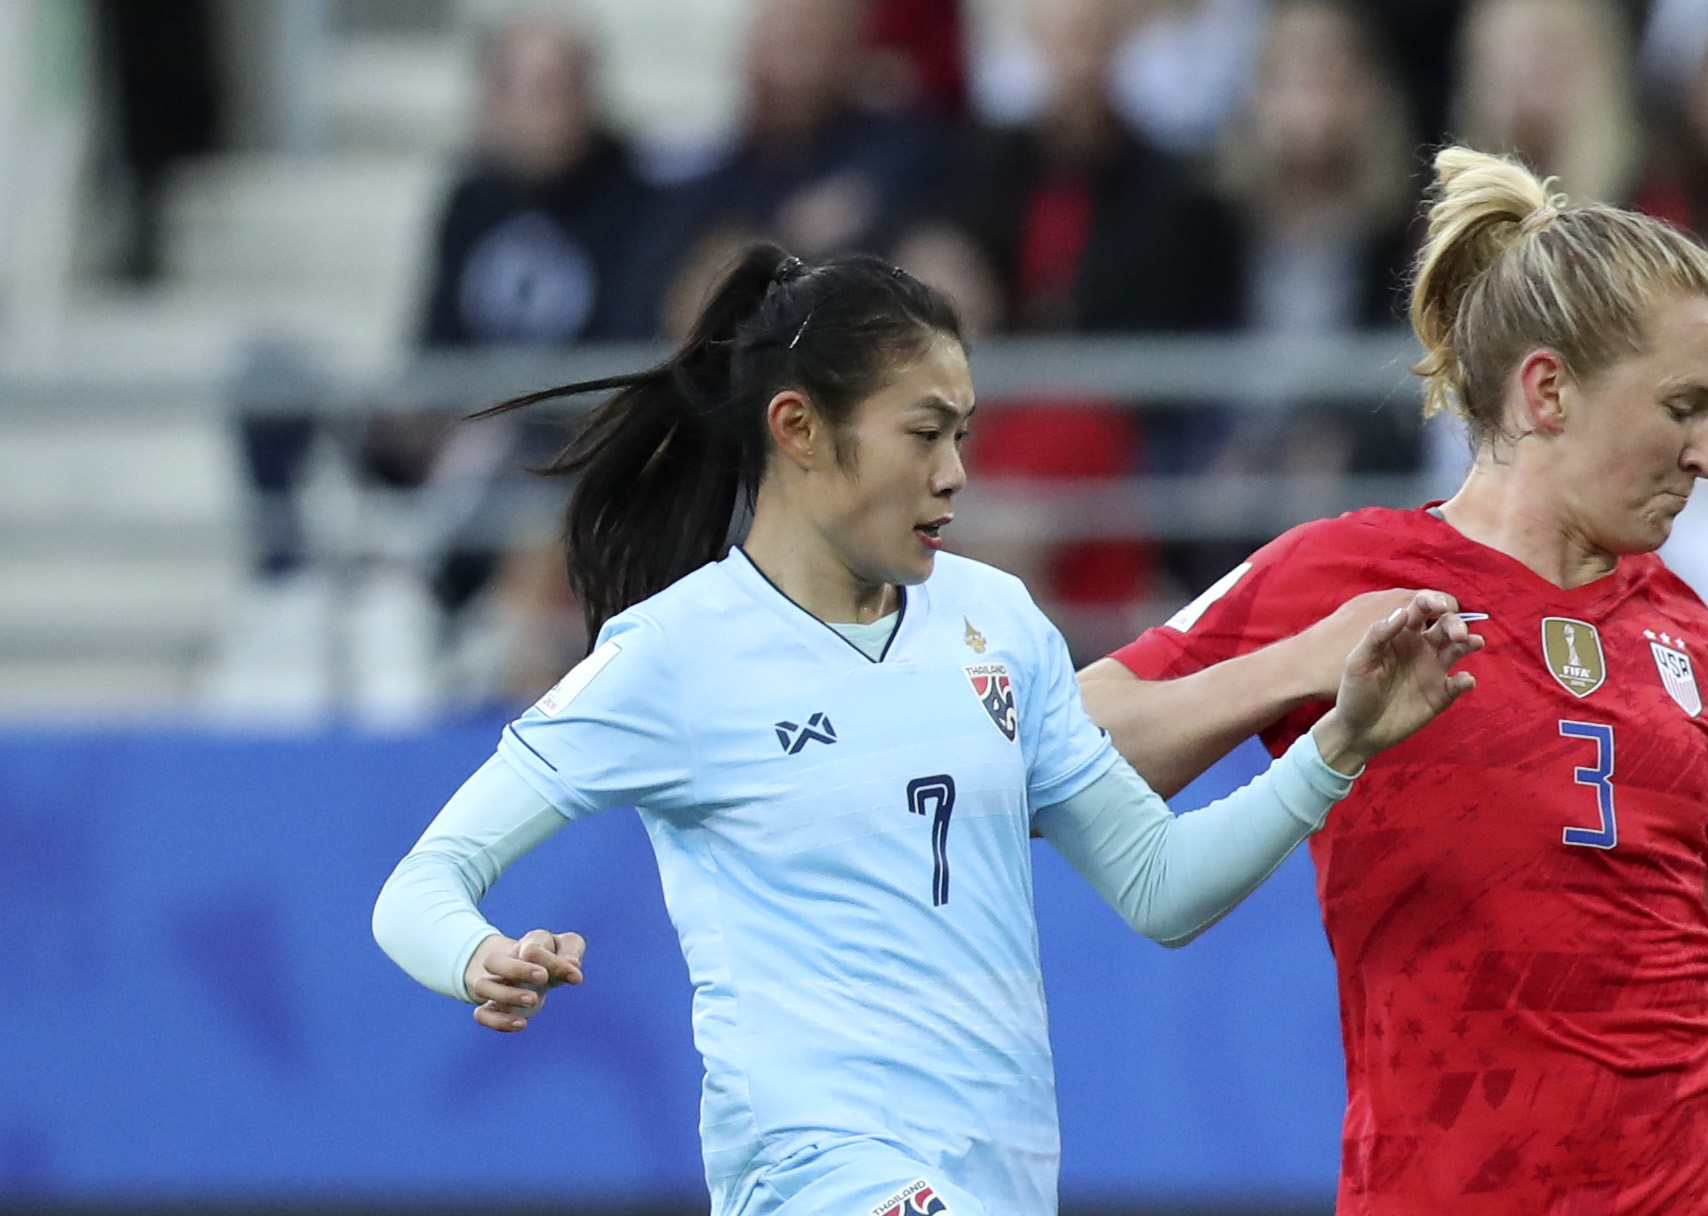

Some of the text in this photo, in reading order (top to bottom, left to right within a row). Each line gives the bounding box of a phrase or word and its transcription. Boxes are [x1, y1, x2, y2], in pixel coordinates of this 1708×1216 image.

[965, 664, 1007, 677] THAILAND
[1562, 665, 1590, 678] FIFA
[1655, 647, 1690, 679] USA
[1558, 719, 1617, 850] 3
[906, 774, 956, 907] 7
[872, 1180, 927, 1216] THAILAND
